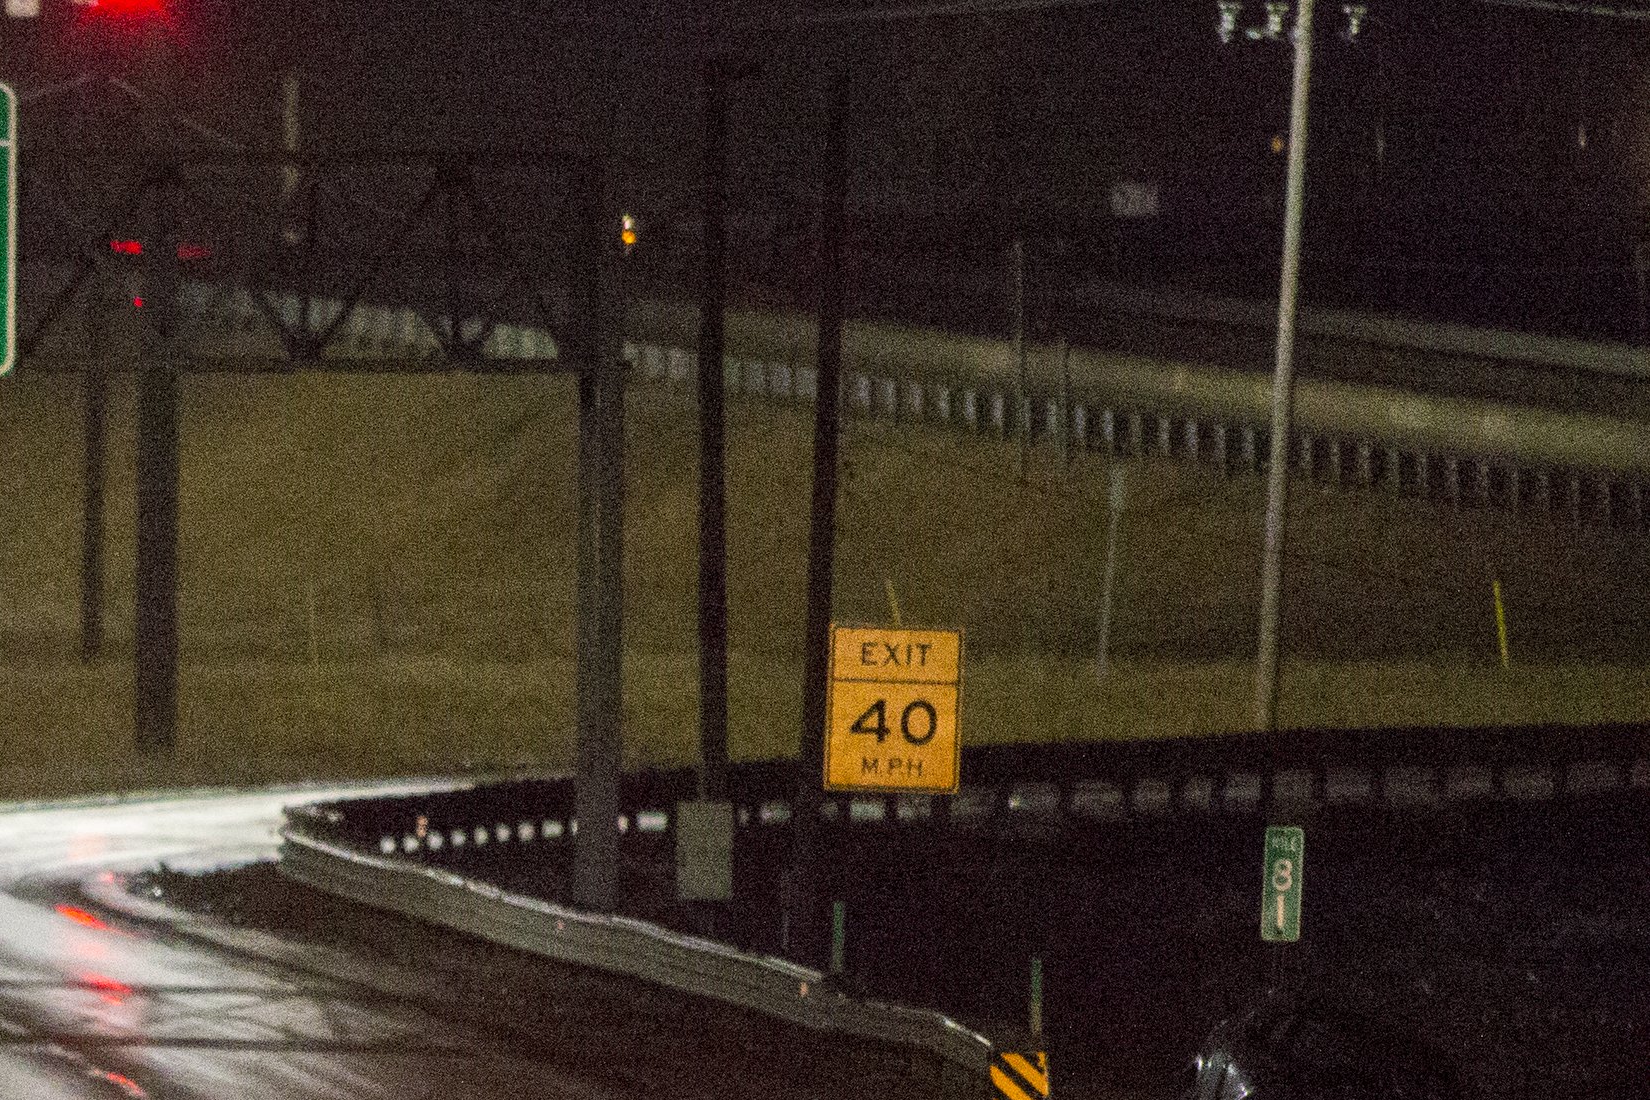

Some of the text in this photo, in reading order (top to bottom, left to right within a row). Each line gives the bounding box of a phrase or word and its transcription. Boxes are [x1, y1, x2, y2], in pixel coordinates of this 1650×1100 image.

[861, 641, 933, 667] EXIT
[851, 698, 938, 746] 40
[861, 757, 923, 777] MPH
